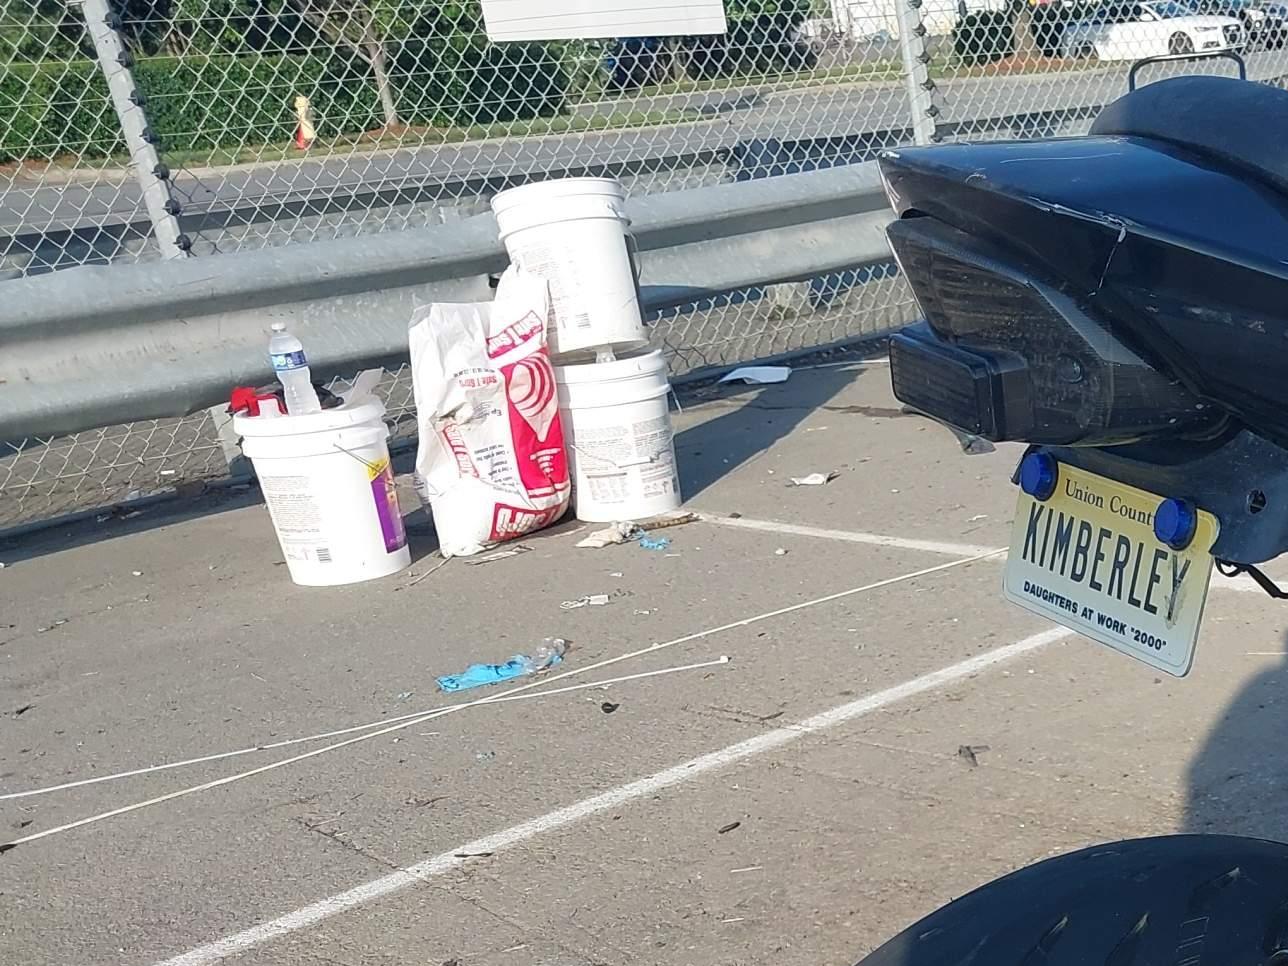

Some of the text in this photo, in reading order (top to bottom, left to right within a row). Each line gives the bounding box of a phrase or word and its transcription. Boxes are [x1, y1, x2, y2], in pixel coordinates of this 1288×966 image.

[1065, 478, 1154, 532] Union Count
[1022, 501, 1191, 621] KIMBERLEY
[1023, 580, 1078, 614] DAUGHTERS
[1080, 606, 1094, 621] AT
[1097, 612, 1127, 636] WORK
